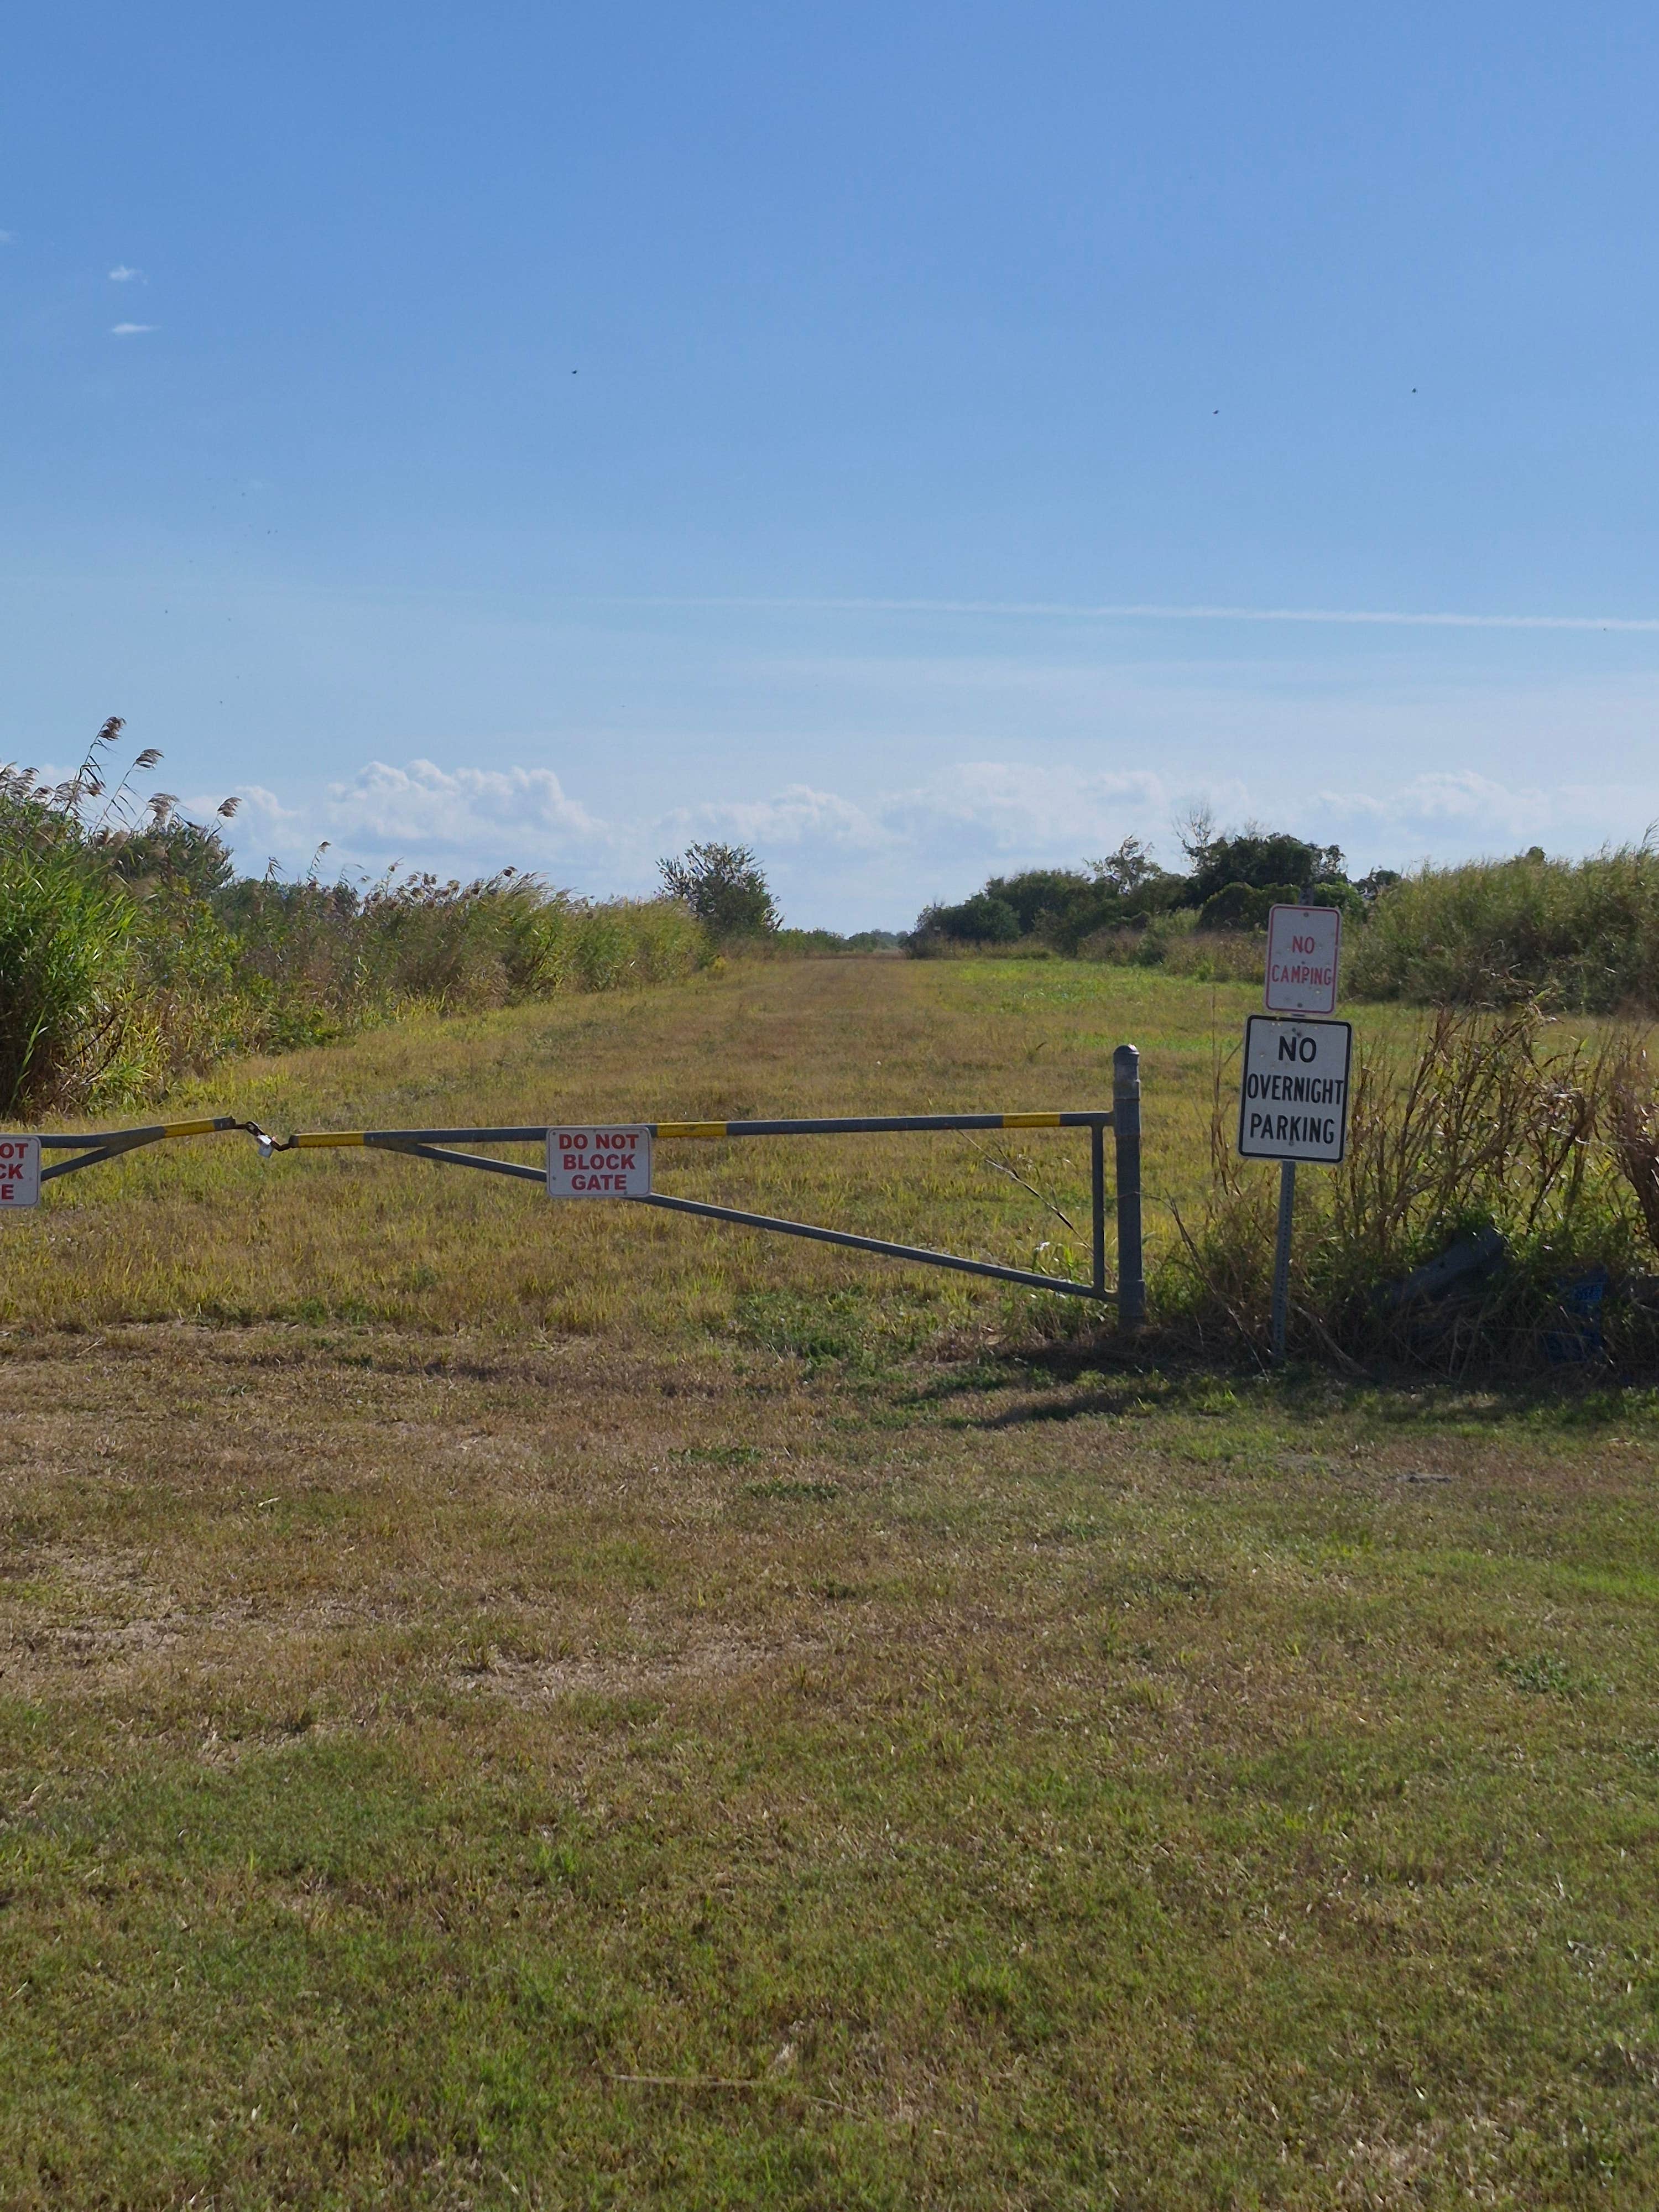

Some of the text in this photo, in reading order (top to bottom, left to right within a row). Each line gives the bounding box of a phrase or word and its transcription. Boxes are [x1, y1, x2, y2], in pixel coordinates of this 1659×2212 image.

[1292, 936, 1314, 954] NO
[1272, 964, 1332, 985] CAMPING
[1279, 1036, 1316, 1062] NO
[1248, 1073, 1344, 1104] OVERNIGHT
[1250, 1113, 1334, 1144] PARKING
[559, 1134, 639, 1149] DO NOT
[0, 1143, 28, 1159] OT
[564, 1154, 635, 1170] BLOCK
[572, 1175, 627, 1190] GATE
